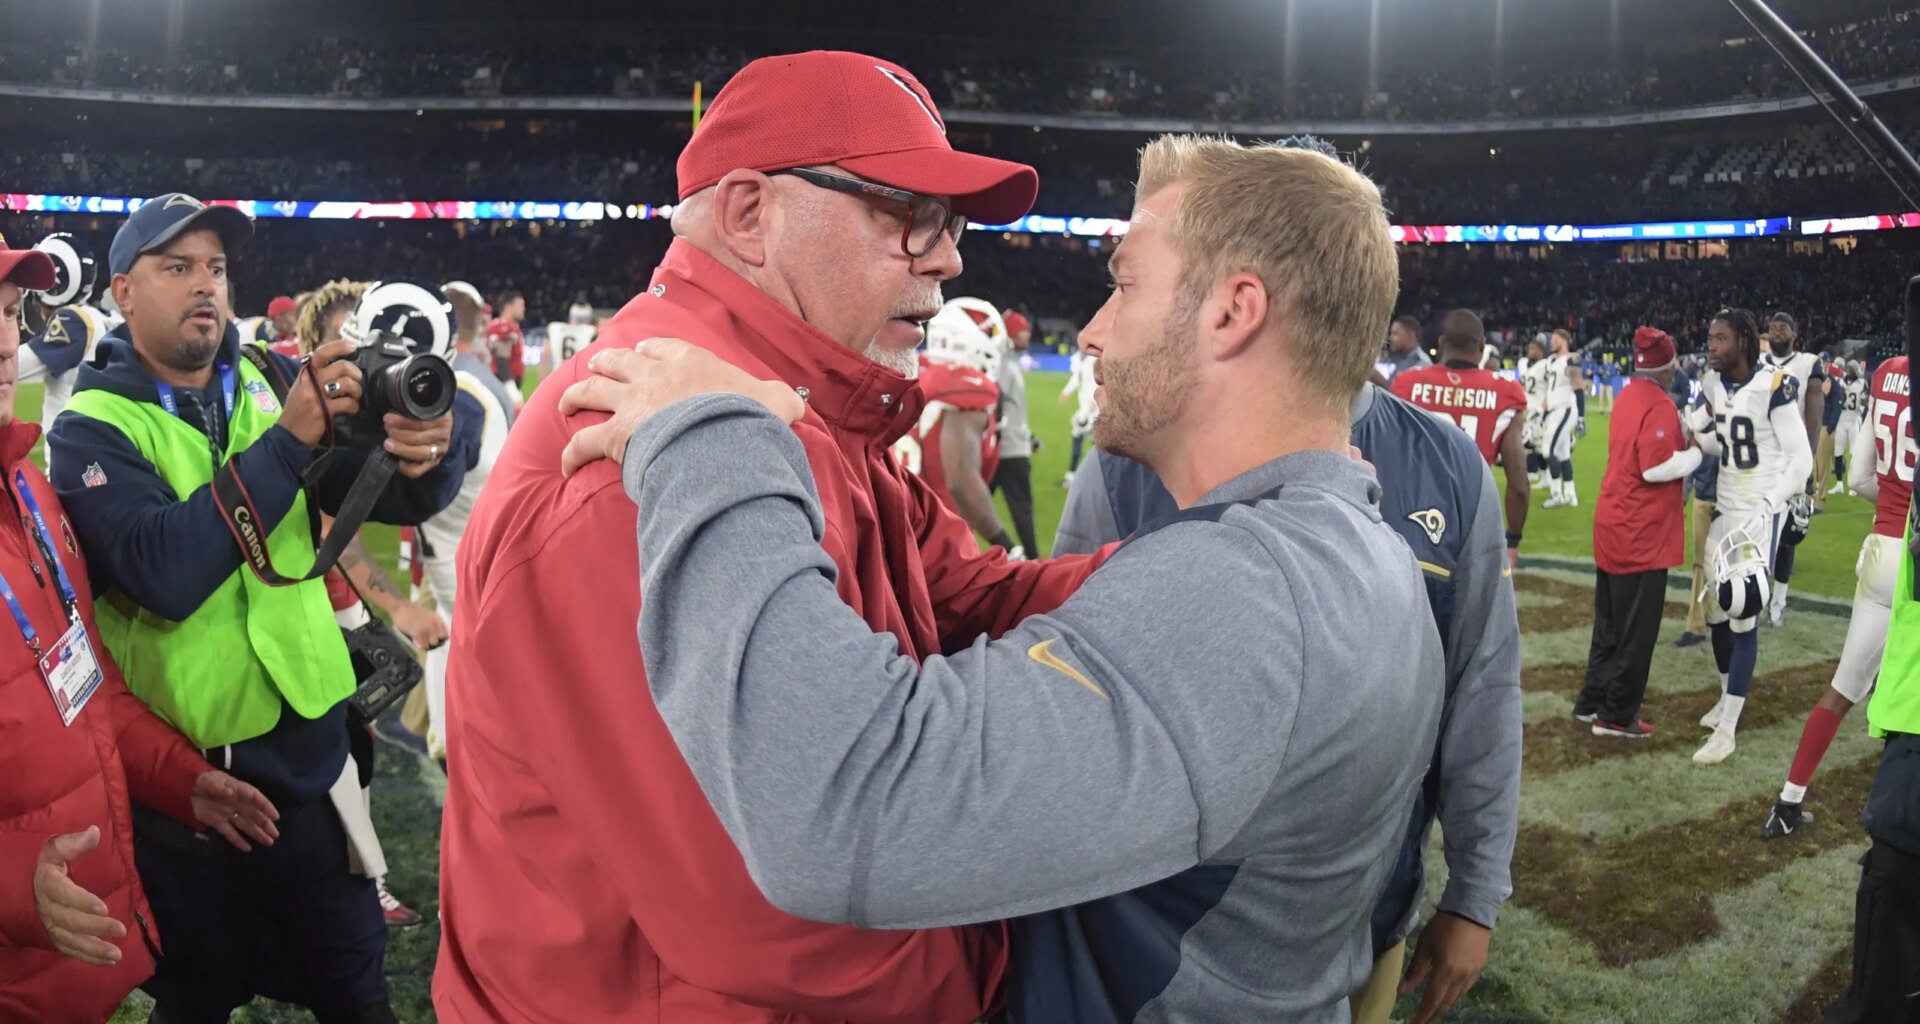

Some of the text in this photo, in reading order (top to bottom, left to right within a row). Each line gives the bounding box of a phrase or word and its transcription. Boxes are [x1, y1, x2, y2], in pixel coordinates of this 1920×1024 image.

[1410, 382, 1497, 411] PETERSON
[1715, 414, 1760, 470] 58
[1874, 398, 1919, 483] 56
[234, 505, 267, 571] Canon
